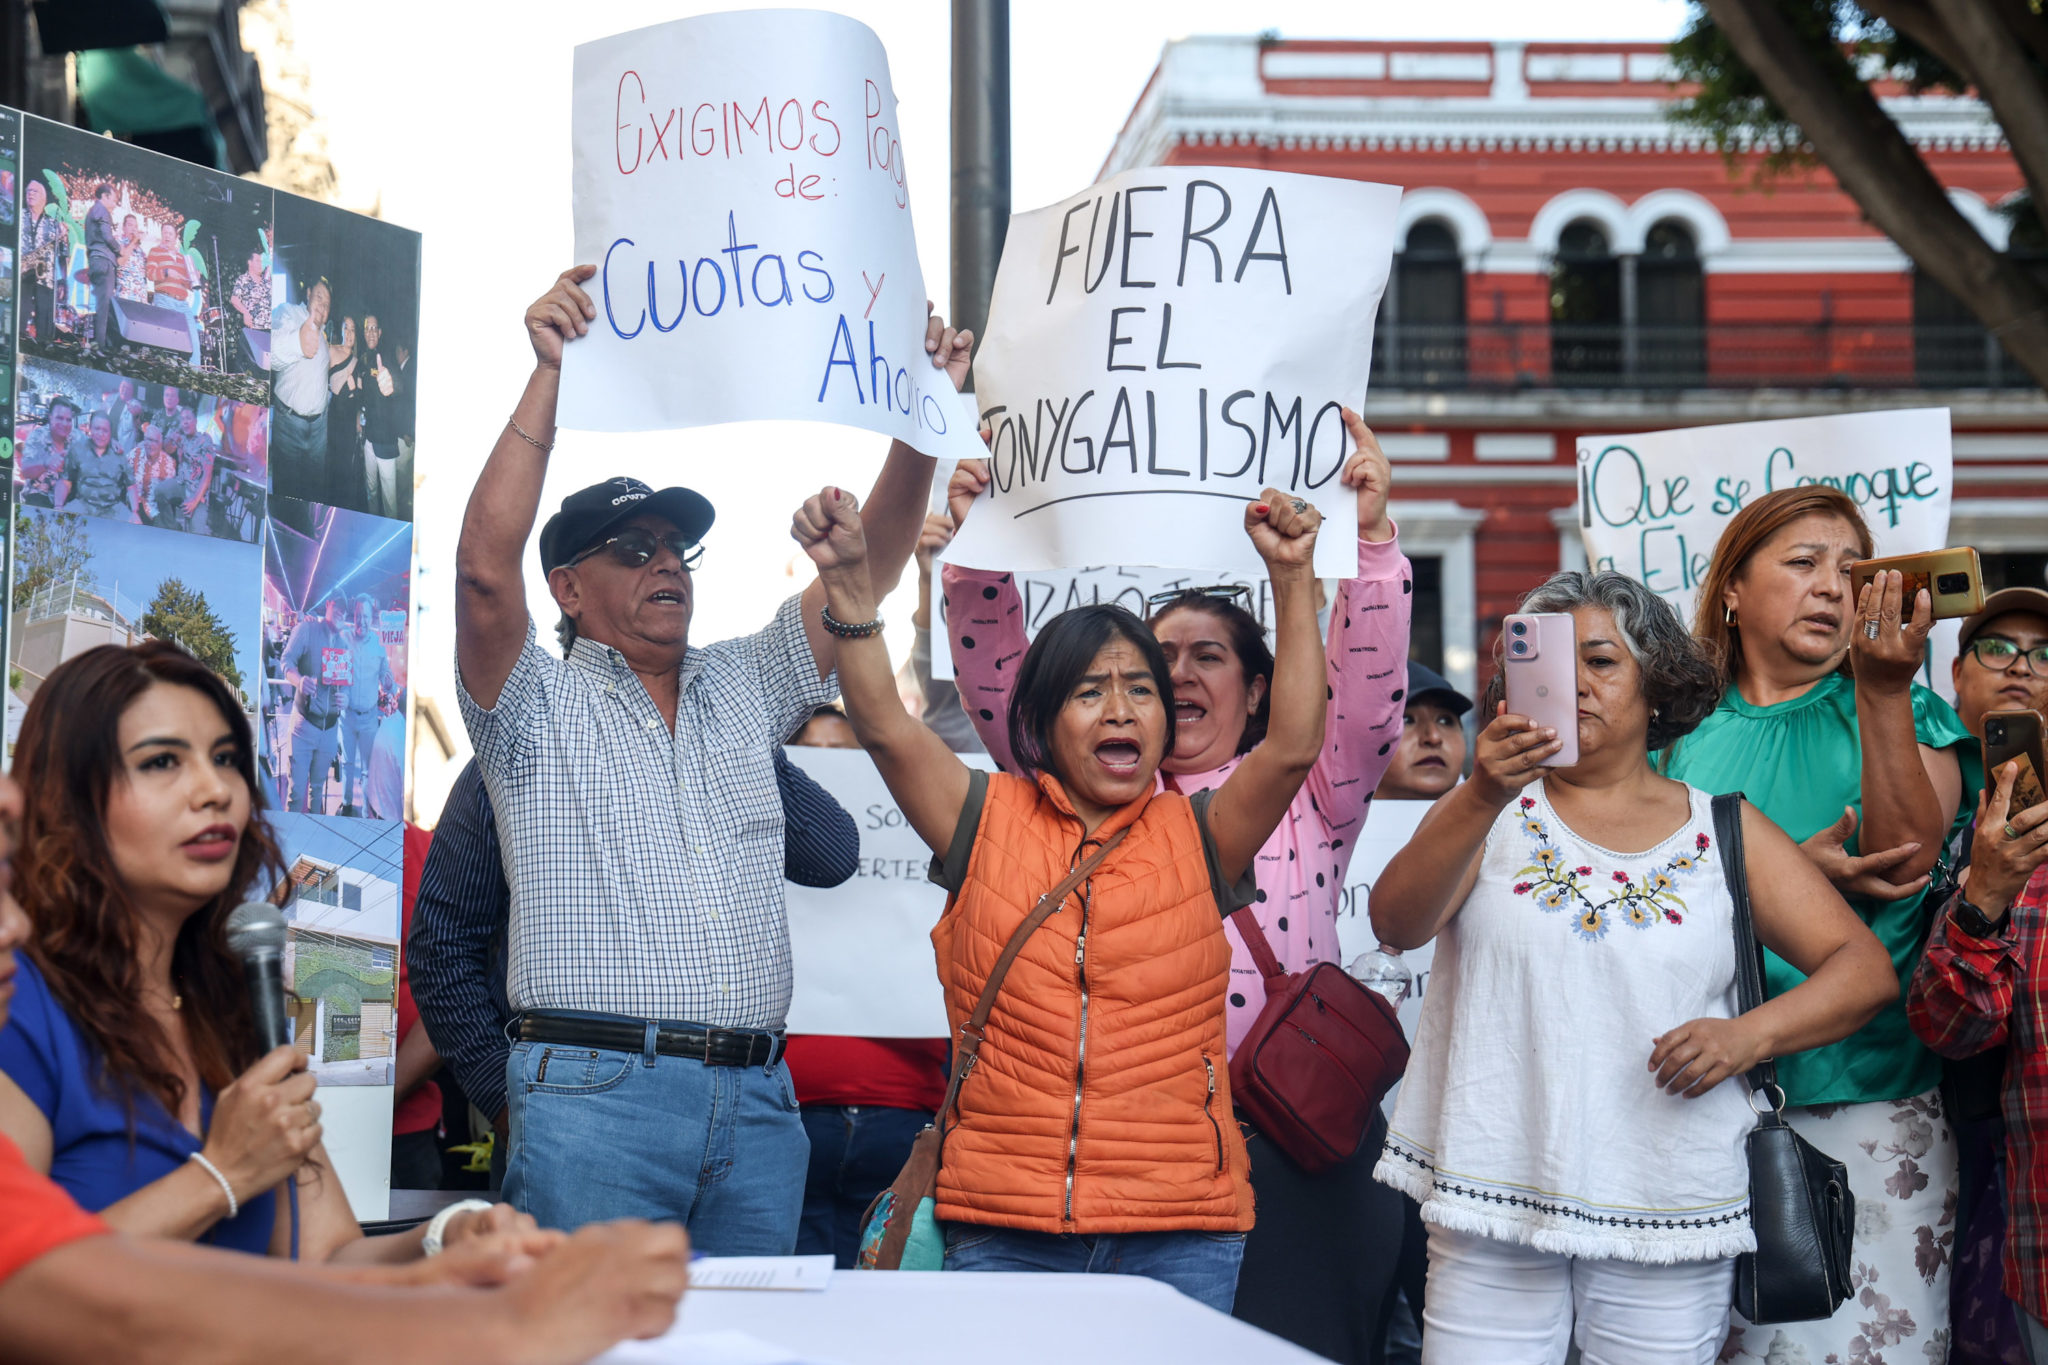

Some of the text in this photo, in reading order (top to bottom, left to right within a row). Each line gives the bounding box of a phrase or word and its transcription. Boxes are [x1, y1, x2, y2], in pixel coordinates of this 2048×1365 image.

[774, 163, 839, 201] de:
[603, 209, 835, 340] Cuotas
[1046, 179, 1292, 305] FUERA
[1107, 303, 1202, 372] EL
[981, 386, 1347, 498] TONYGALISMO
[866, 804, 909, 830] SO
